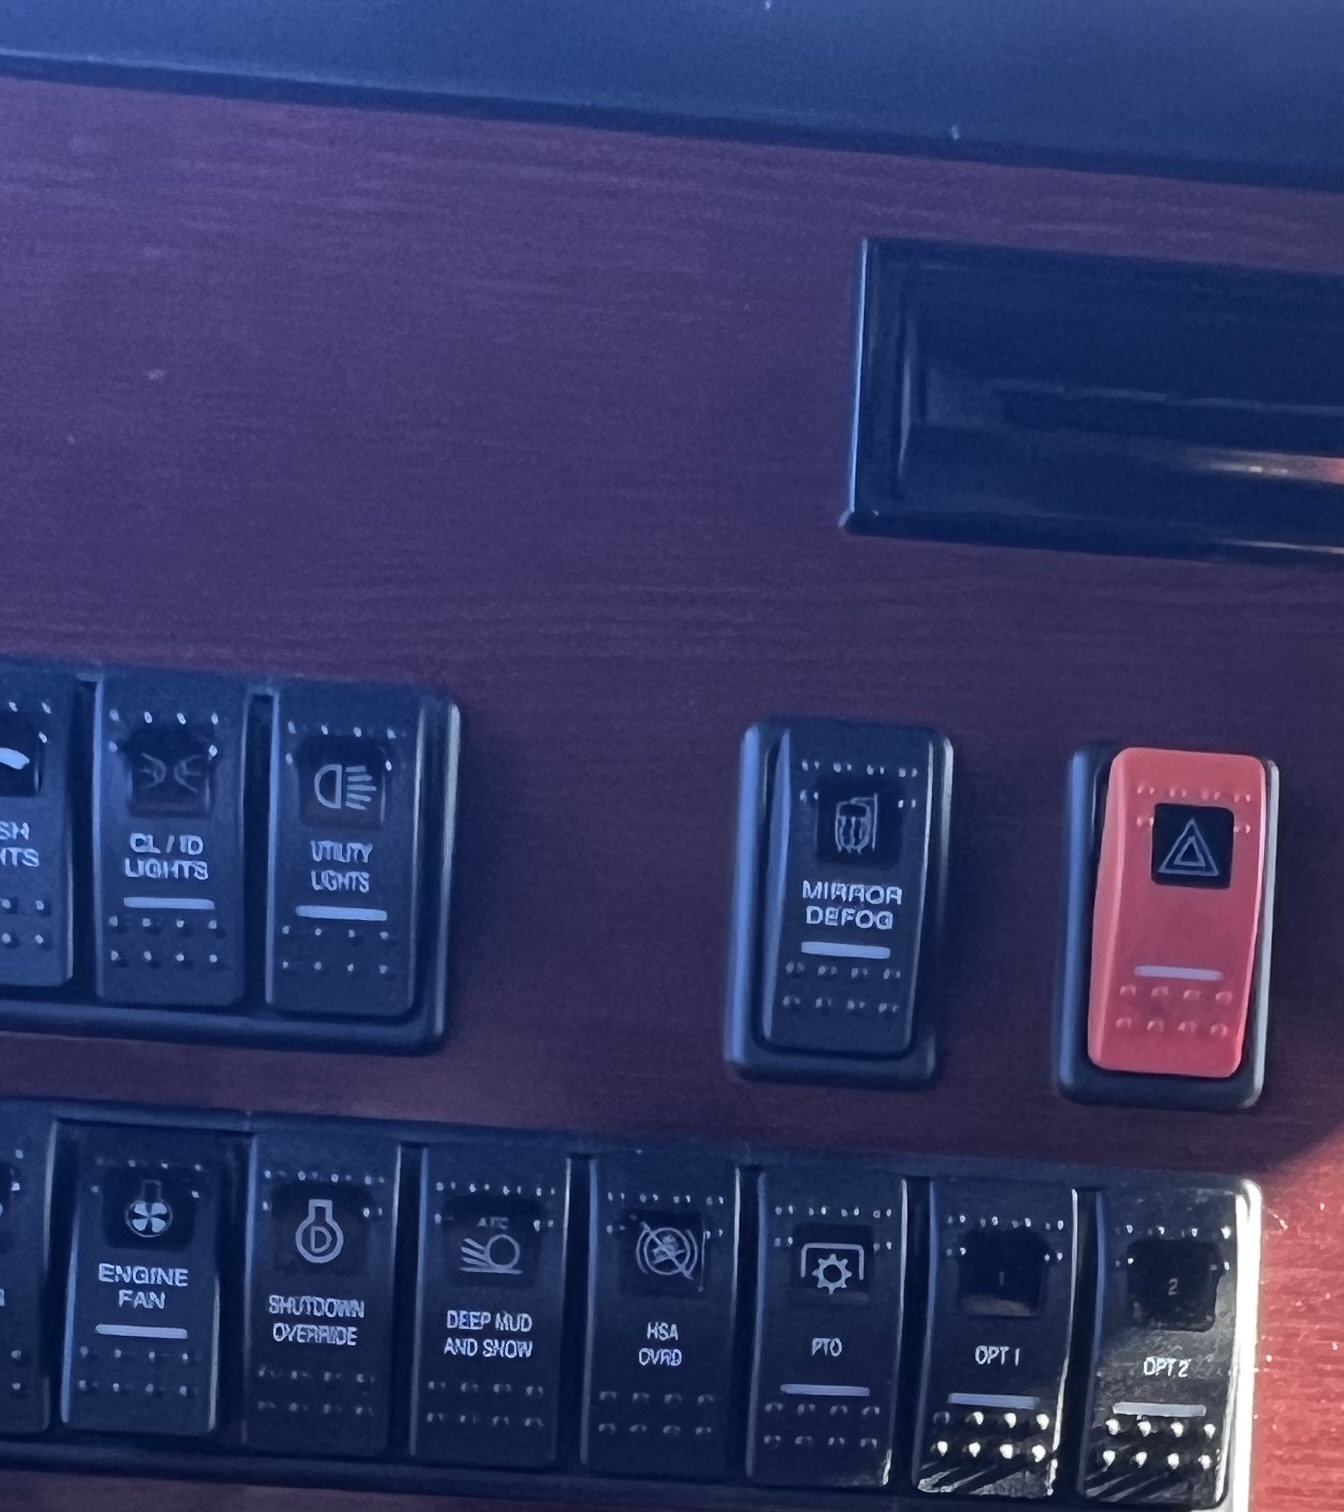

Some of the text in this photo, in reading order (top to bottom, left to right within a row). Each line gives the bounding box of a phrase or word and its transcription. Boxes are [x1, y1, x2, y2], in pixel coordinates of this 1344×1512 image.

[129, 833, 161, 854] CL
[181, 834, 205, 857] ID
[310, 840, 374, 865] UTILITY
[124, 857, 210, 881] LIGHTS
[311, 870, 371, 893] LIGHTS
[802, 880, 903, 905] MIRROR
[806, 906, 894, 930] DEFOG
[98, 1263, 189, 1288] ENGINE
[118, 1289, 166, 1310] FAN
[268, 1295, 365, 1319] SHUTDOWN
[446, 1309, 533, 1333] DEEP MUD
[646, 1322, 679, 1342] HSA
[272, 1322, 358, 1347] OVERRIDE
[443, 1336, 479, 1357] AND
[812, 1336, 842, 1357] PTO
[638, 1348, 682, 1367] OVRD
[975, 1346, 1011, 1366] OPT
[1143, 1357, 1191, 1378] OPT 2
